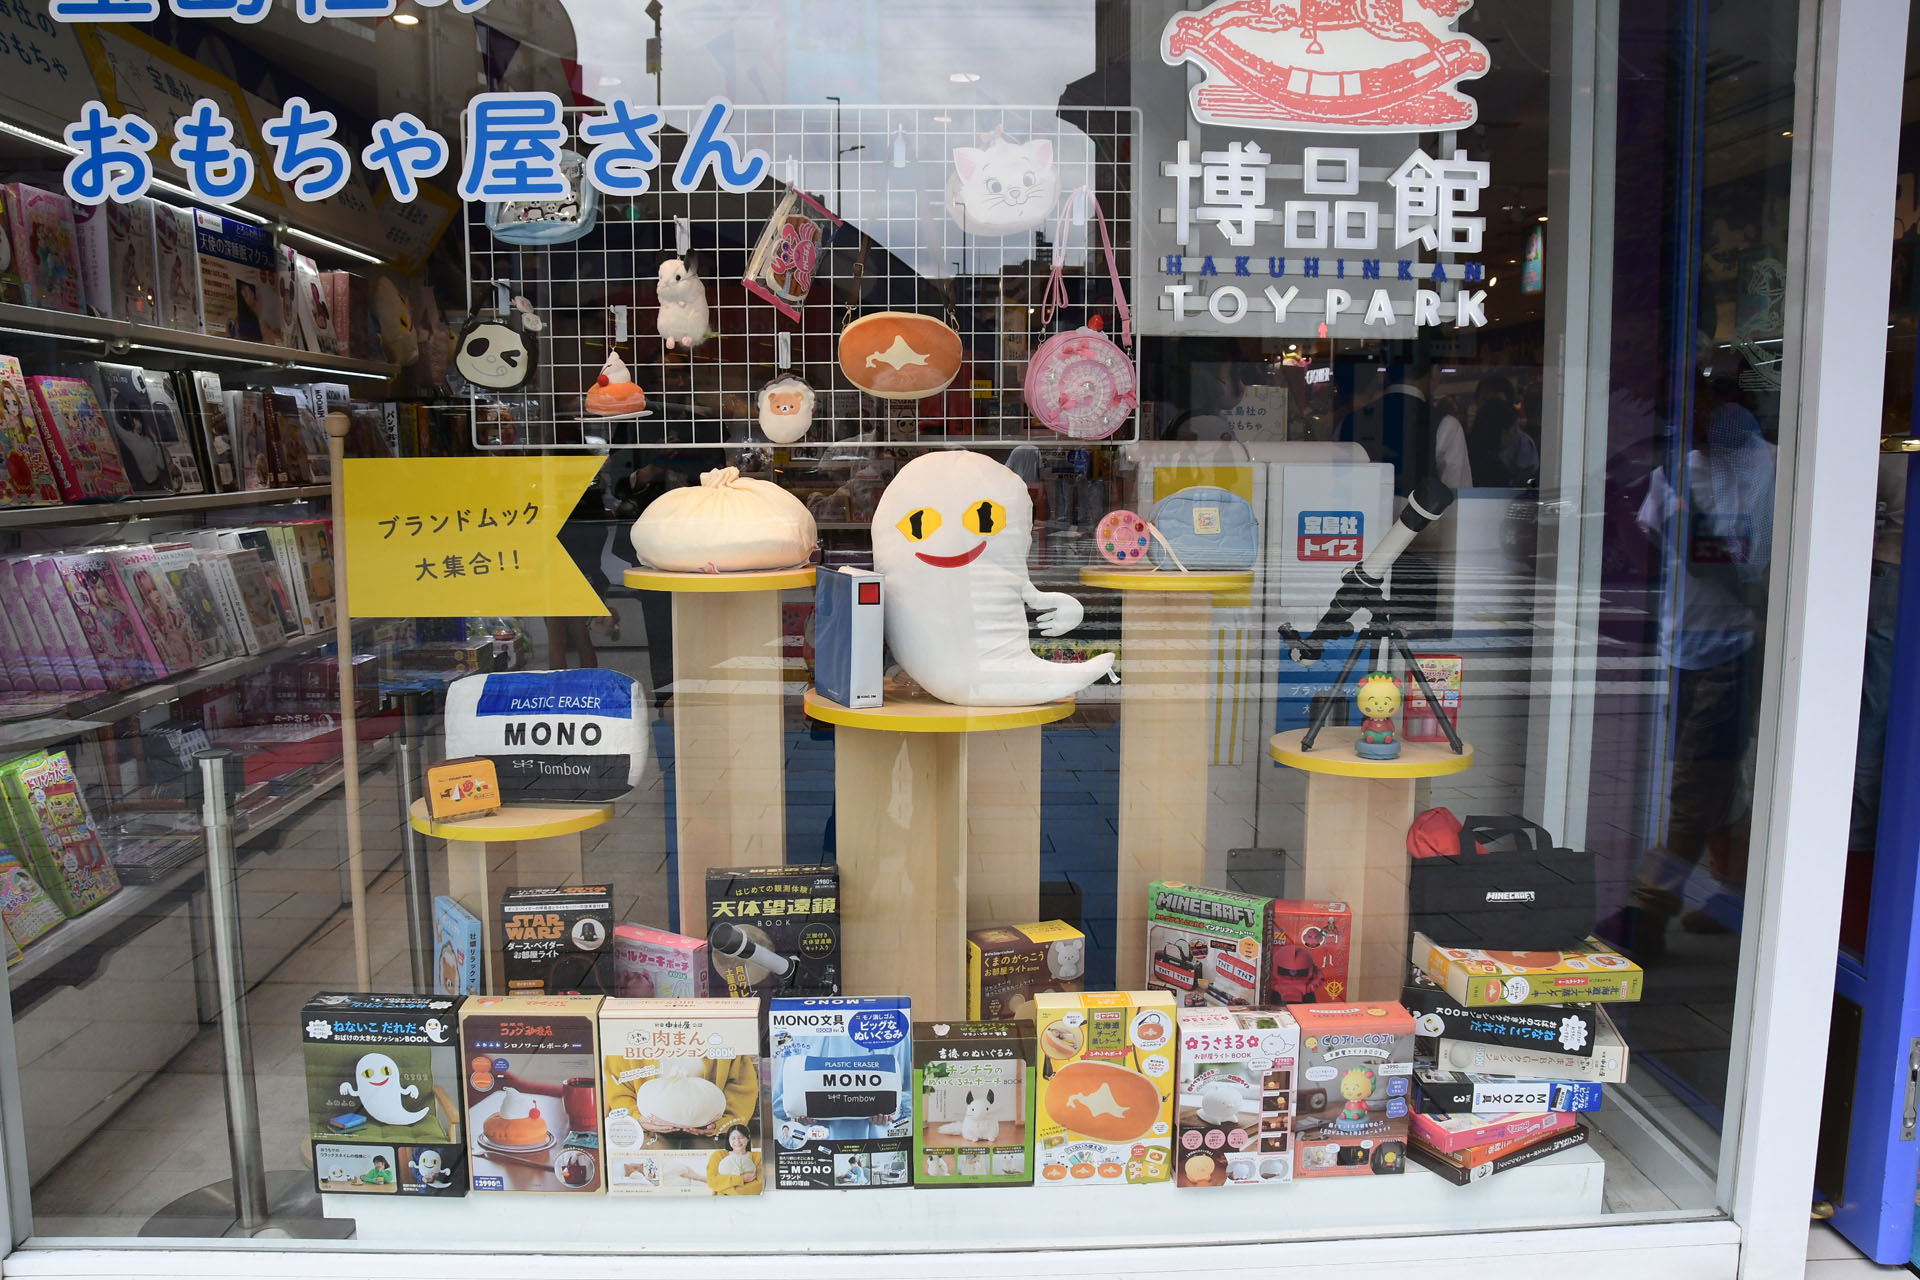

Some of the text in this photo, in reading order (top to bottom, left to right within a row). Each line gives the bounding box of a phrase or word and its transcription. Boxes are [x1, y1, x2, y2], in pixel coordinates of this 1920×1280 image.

[66, 95, 767, 202] おもちゃ屋さん
[1165, 140, 1491, 253] 博品館
[1166, 254, 1483, 282] HAKUHINKAN
[1165, 285, 1489, 327] TOY PARK
[378, 502, 539, 539] ブランドムック
[1304, 538, 1358, 556] トイズ
[510, 696, 601, 710] PLASTIC ERASER
[504, 722, 603, 746] MONO
[538, 761, 591, 776] Tombow
[712, 898, 837, 918] 天体望遠鏡
[1156, 892, 1255, 927] MINECRAFT
[509, 914, 564, 927] STAR
[505, 927, 564, 940] WARS
[513, 951, 559, 960] お部屋ライト
[984, 951, 1045, 968] くまのがっこう
[1158, 966, 1171, 977] TNT
[1217, 959, 1231, 971] TNT
[1177, 973, 1190, 983] TNT
[1237, 969, 1253, 981] TNT
[773, 1015, 844, 1026] MONO文具
[860, 1021, 897, 1031] ビッグな
[334, 1021, 378, 1033] ねないこ
[382, 1021, 417, 1034] だれだ
[1470, 1020, 1556, 1041] ねないこ だれだ
[653, 1030, 705, 1046] 肉まん
[854, 1032, 903, 1041] ぬいぐるみ
[1201, 1035, 1244, 1050] うさまる
[1321, 1033, 1396, 1046] COJI-COJI
[947, 1064, 1003, 1077] チンチラの
[823, 1074, 882, 1087] MONO
[843, 1095, 876, 1103] Tombow
[1482, 1094, 1547, 1104] MONO文具
[791, 1165, 832, 1174] MONO
